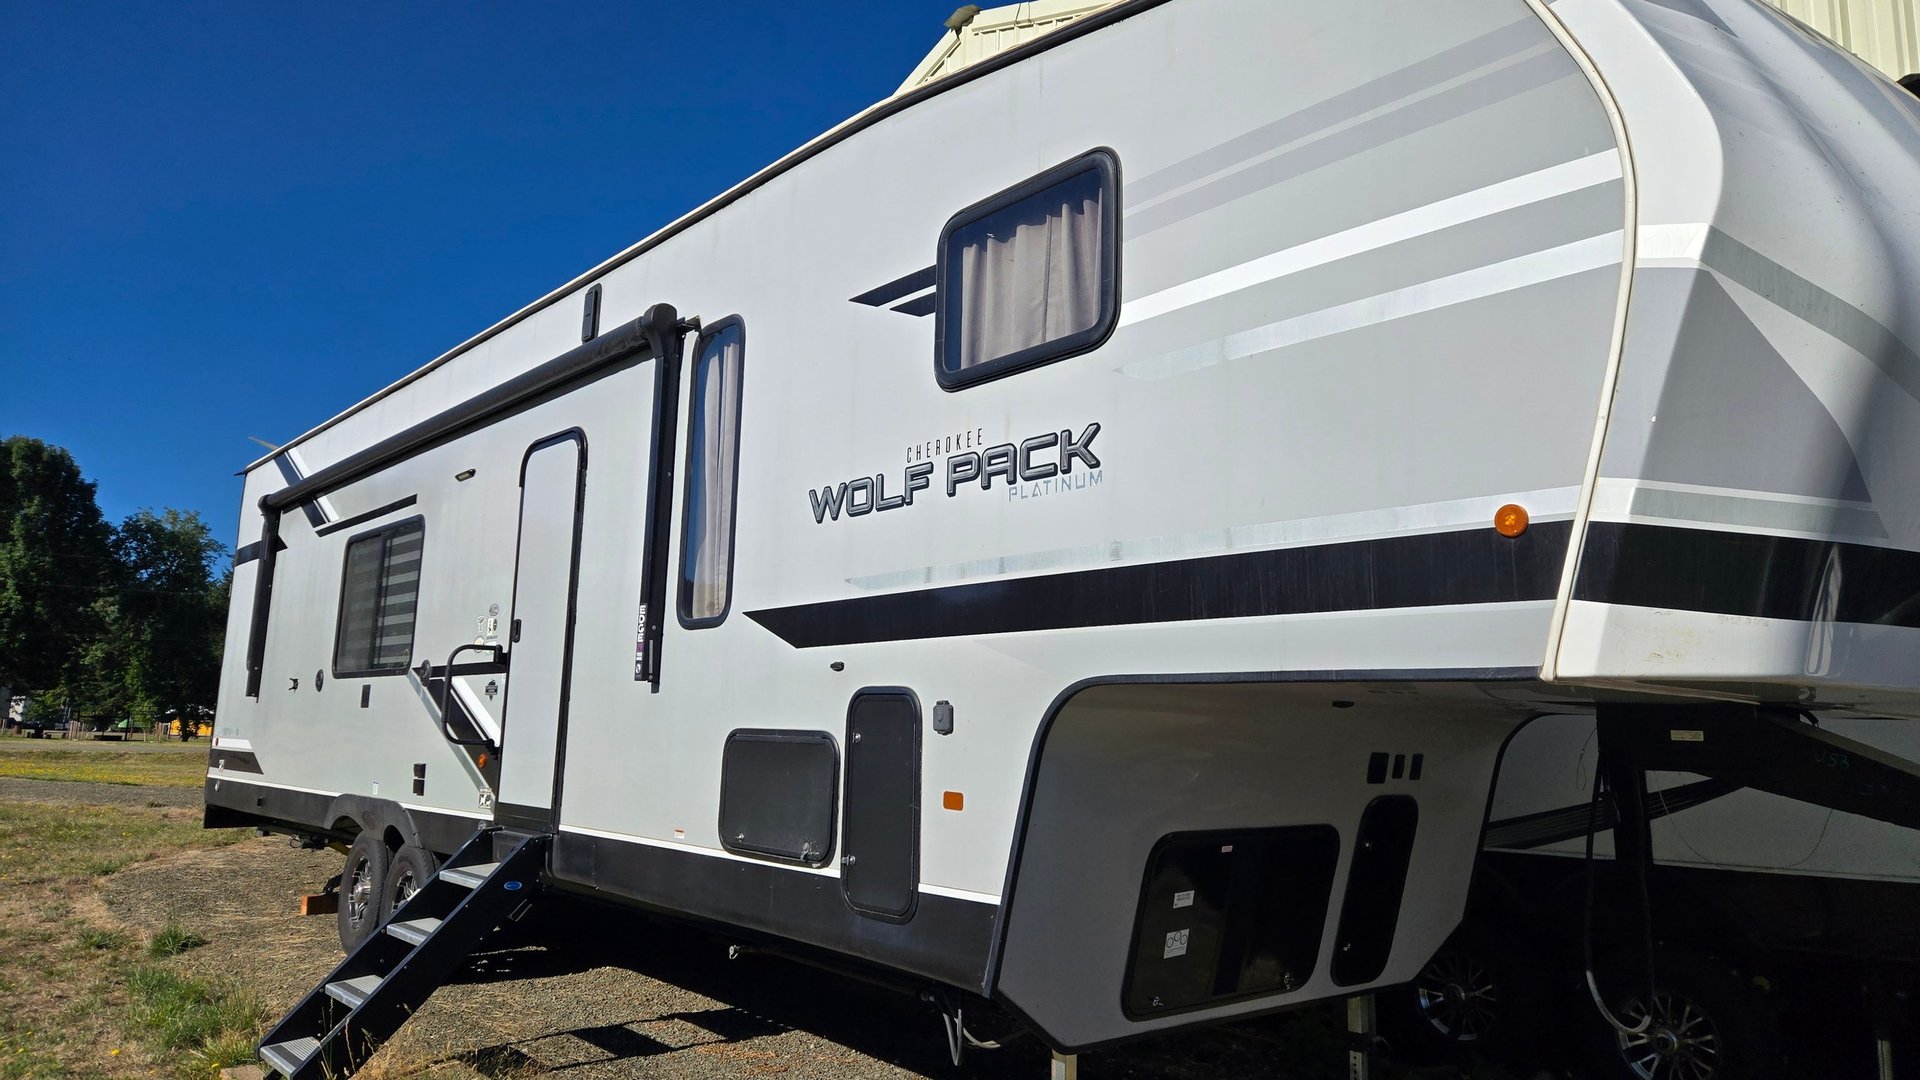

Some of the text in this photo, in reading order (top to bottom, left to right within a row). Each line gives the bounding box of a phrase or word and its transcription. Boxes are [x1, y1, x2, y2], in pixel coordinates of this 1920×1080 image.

[907, 428, 982, 463] CHEROKEE
[809, 422, 1102, 524] WOLF PACK
[1009, 470, 1103, 502] PLATINUM
